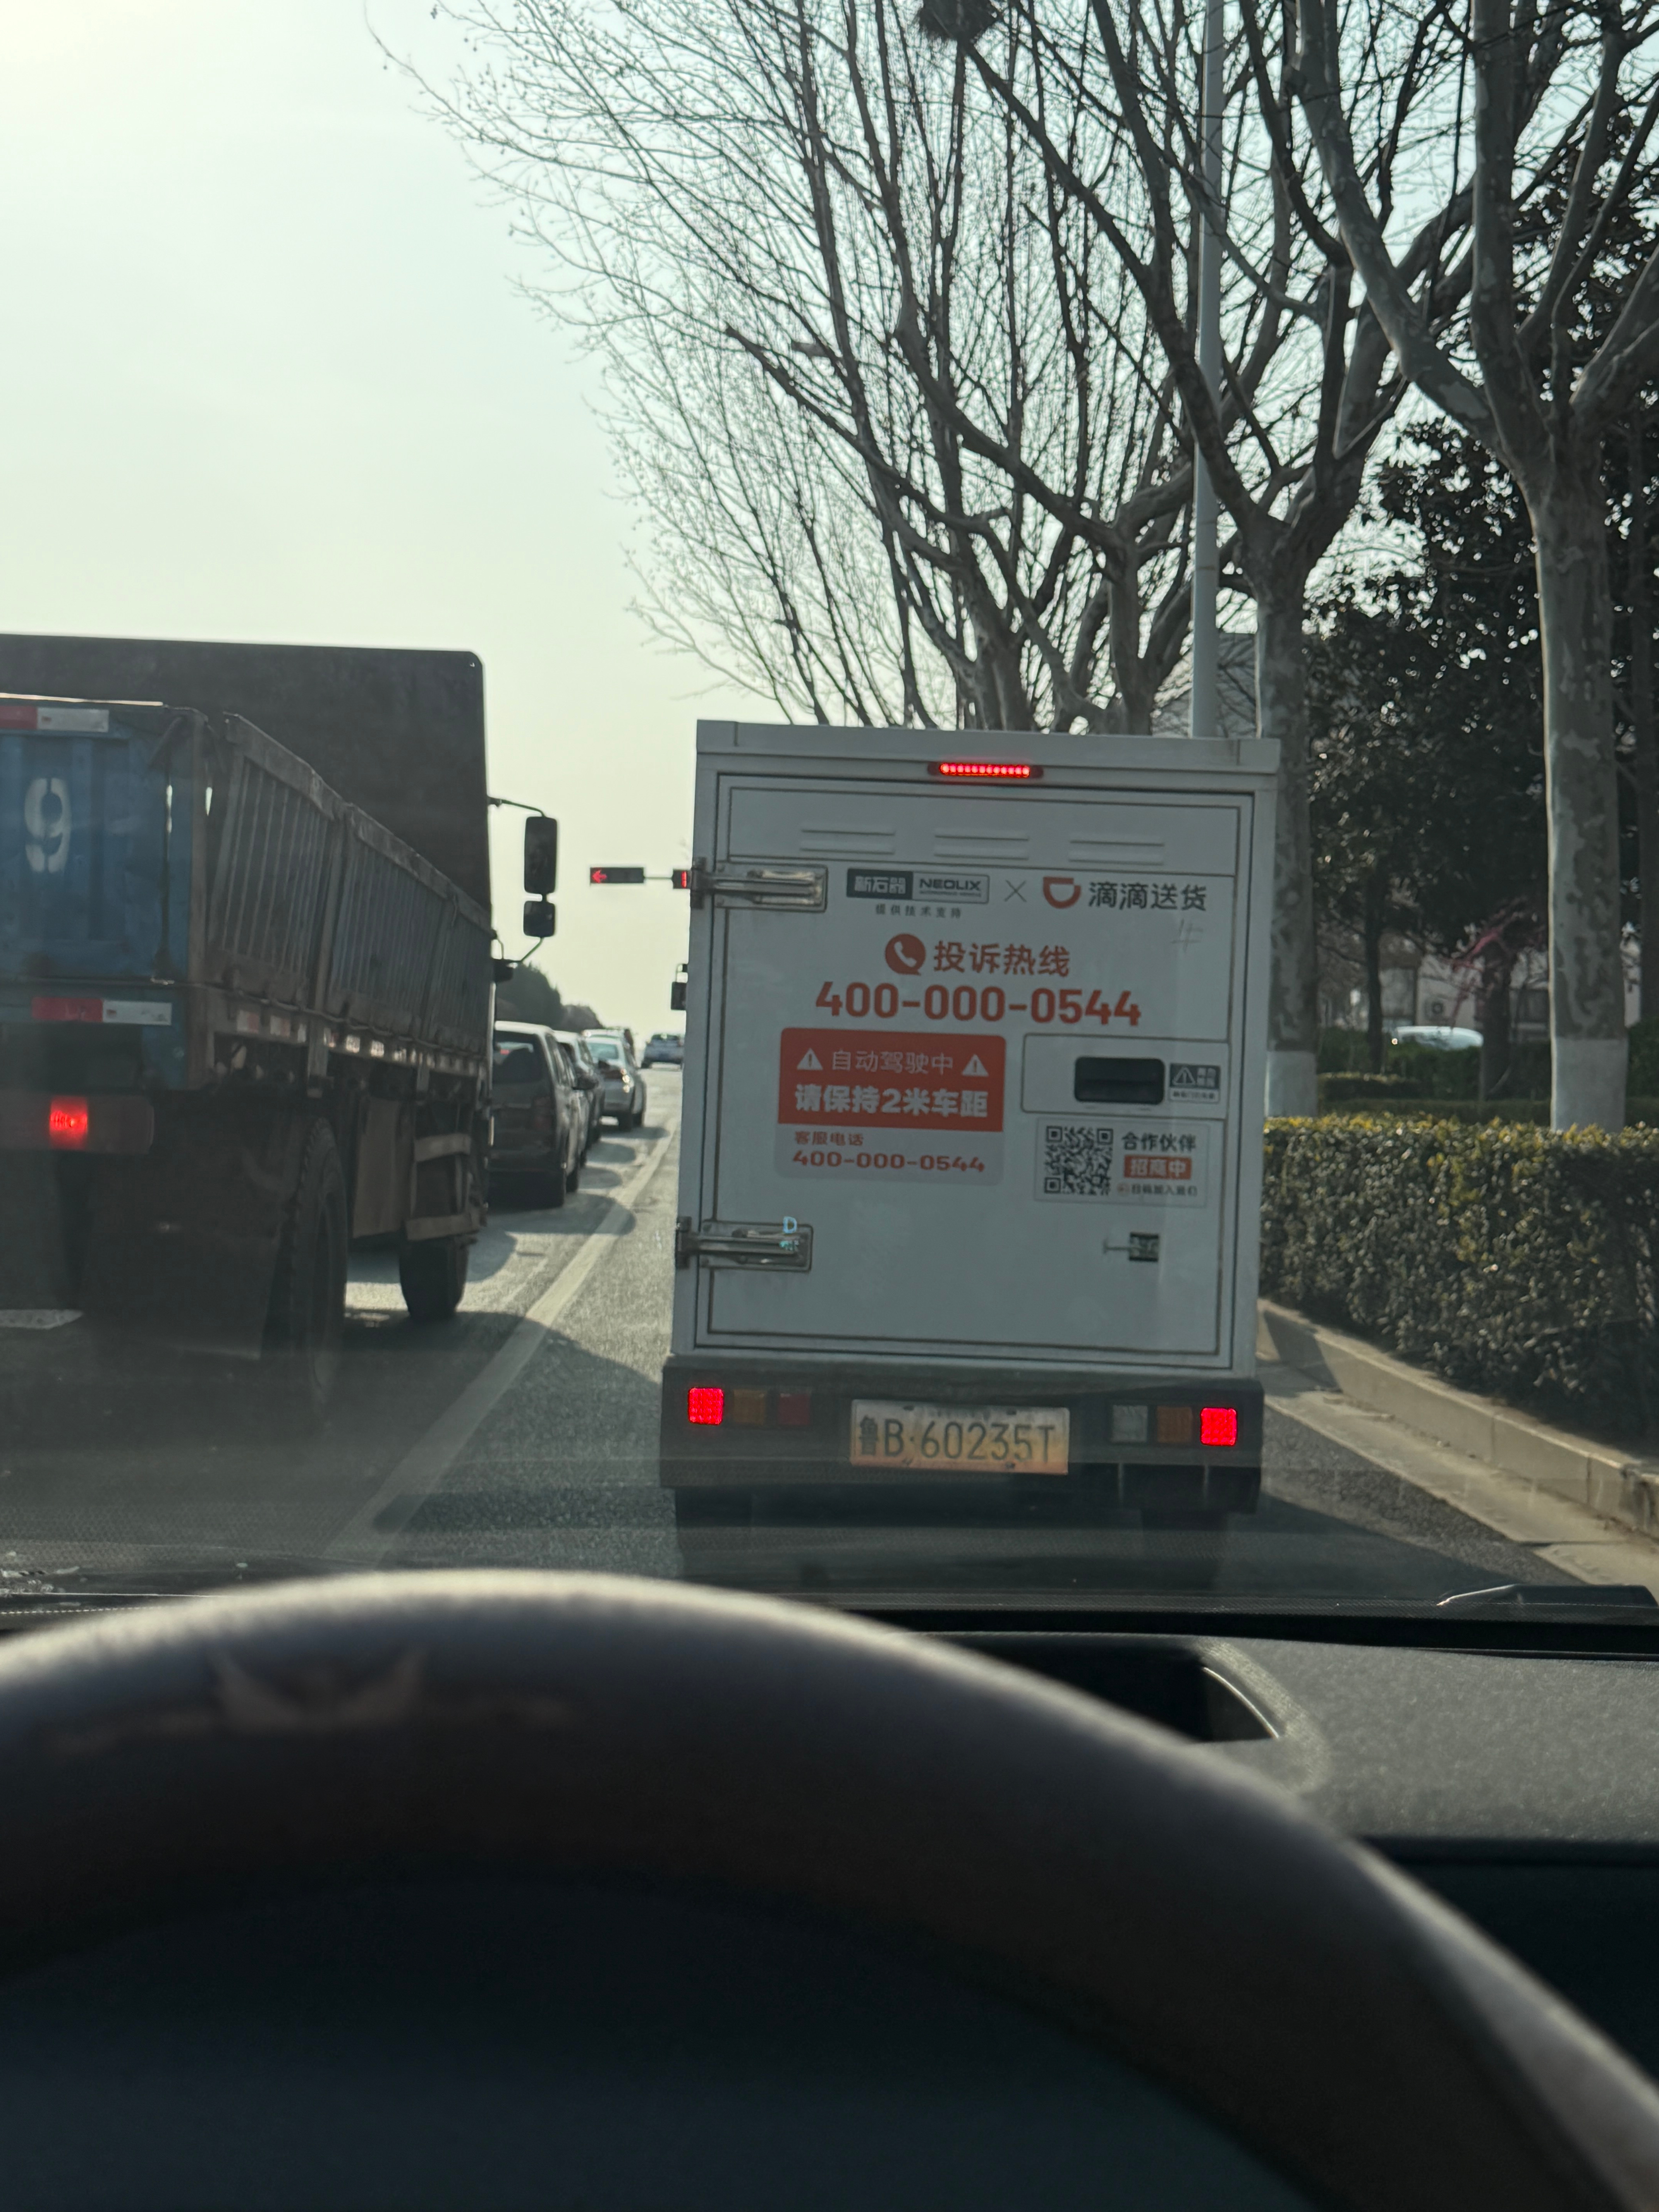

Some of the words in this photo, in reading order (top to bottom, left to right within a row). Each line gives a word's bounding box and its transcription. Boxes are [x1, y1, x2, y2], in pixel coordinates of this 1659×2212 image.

[854, 876, 906, 894] 新石器
[919, 878, 981, 891] NEOLIX
[1089, 881, 1207, 912] 滴滴送货
[875, 903, 962, 919] 提供技术支持
[933, 940, 1070, 977] 投诉热线
[816, 981, 1141, 1026] 400-000-0544
[832, 1050, 953, 1075] 自动驾驶中
[795, 1084, 988, 1118] 请保持2米车距
[795, 1131, 864, 1146] 客服电话
[1121, 1132, 1196, 1152] 合作伙伴
[792, 1150, 985, 1173] 400-000-0544
